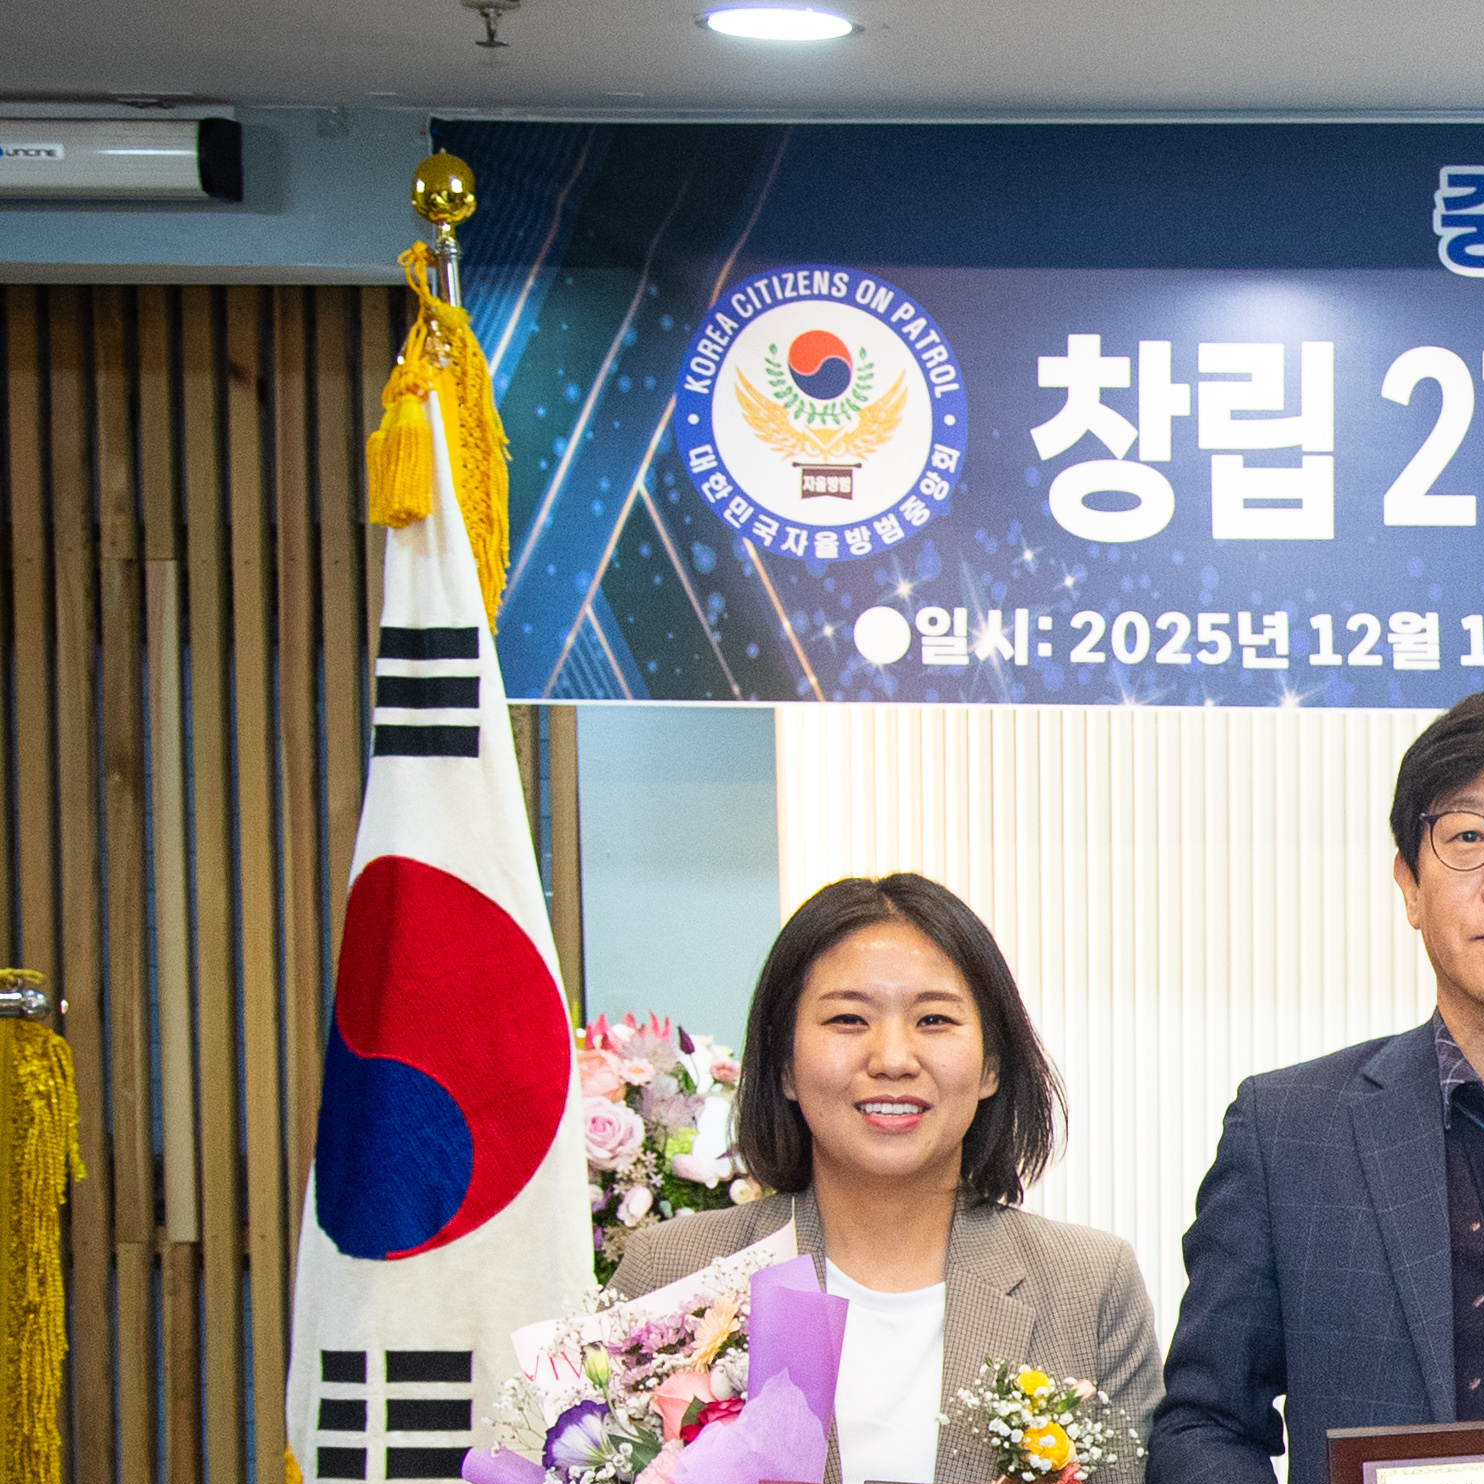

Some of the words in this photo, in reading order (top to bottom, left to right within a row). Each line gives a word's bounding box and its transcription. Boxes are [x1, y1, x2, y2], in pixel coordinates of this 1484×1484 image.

[685, 312, 739, 394] KOREA
[731, 270, 849, 318] CITIZENS
[855, 279, 894, 314] ON
[891, 302, 960, 398] PATROL
[1027, 333, 1335, 543] 창립
[915, 608, 1054, 668] 일시:
[1069, 609, 1290, 670] 2025년
[1308, 611, 1441, 671] 12월
